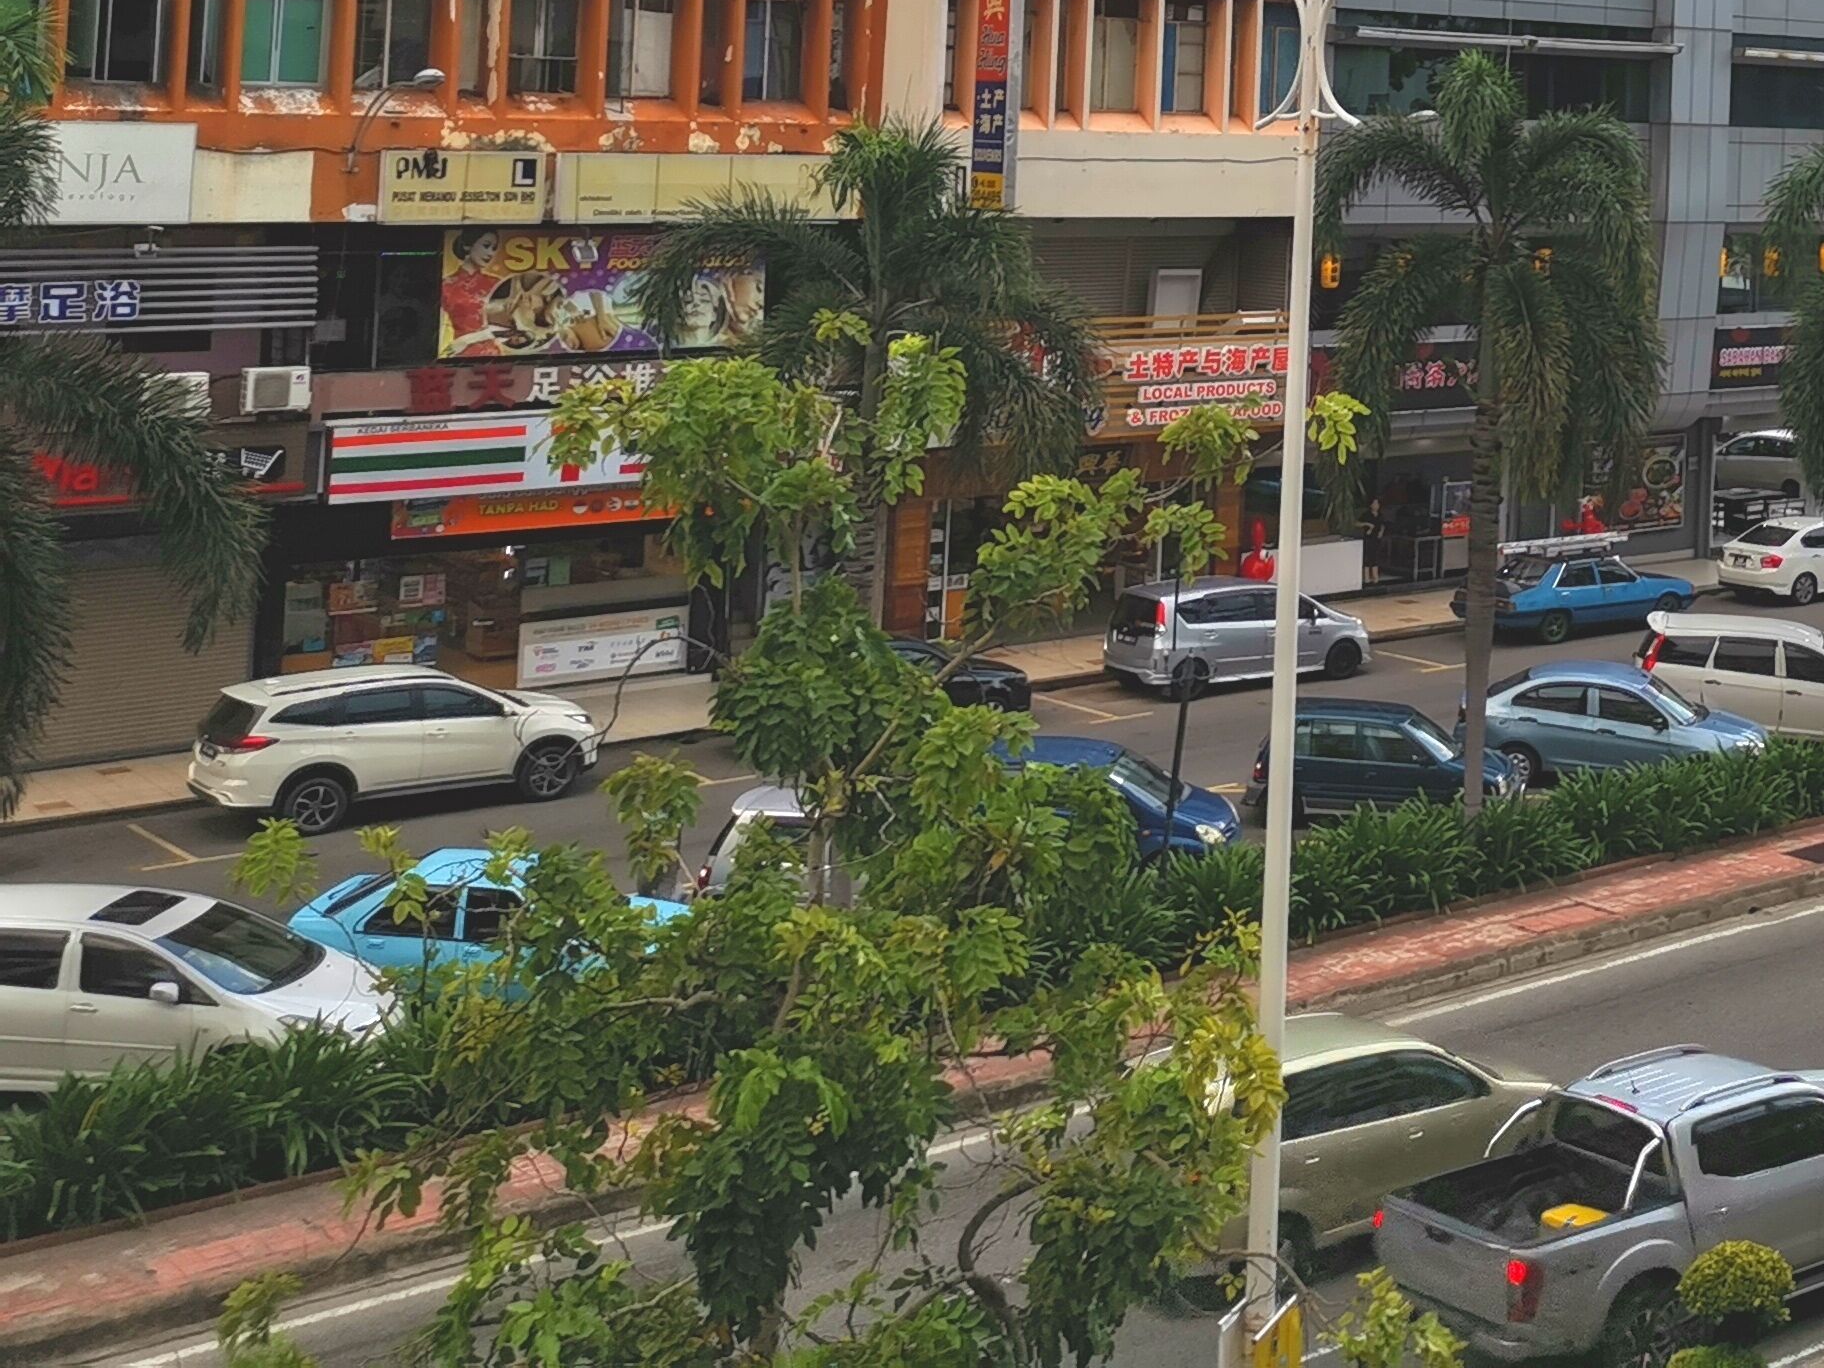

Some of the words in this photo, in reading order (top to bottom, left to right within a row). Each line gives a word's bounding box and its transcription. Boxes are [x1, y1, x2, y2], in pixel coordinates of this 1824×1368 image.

[58, 153, 146, 192] NJA
[406, 362, 672, 413] 蓝天足浴推
[1142, 386, 1192, 401] LOCAL
[1199, 381, 1276, 398] PRODUCTS
[1130, 411, 1143, 424] &
[1149, 406, 1192, 423] FROZ
[1231, 402, 1282, 418] AFOOD
[480, 501, 524, 515] TANPA
